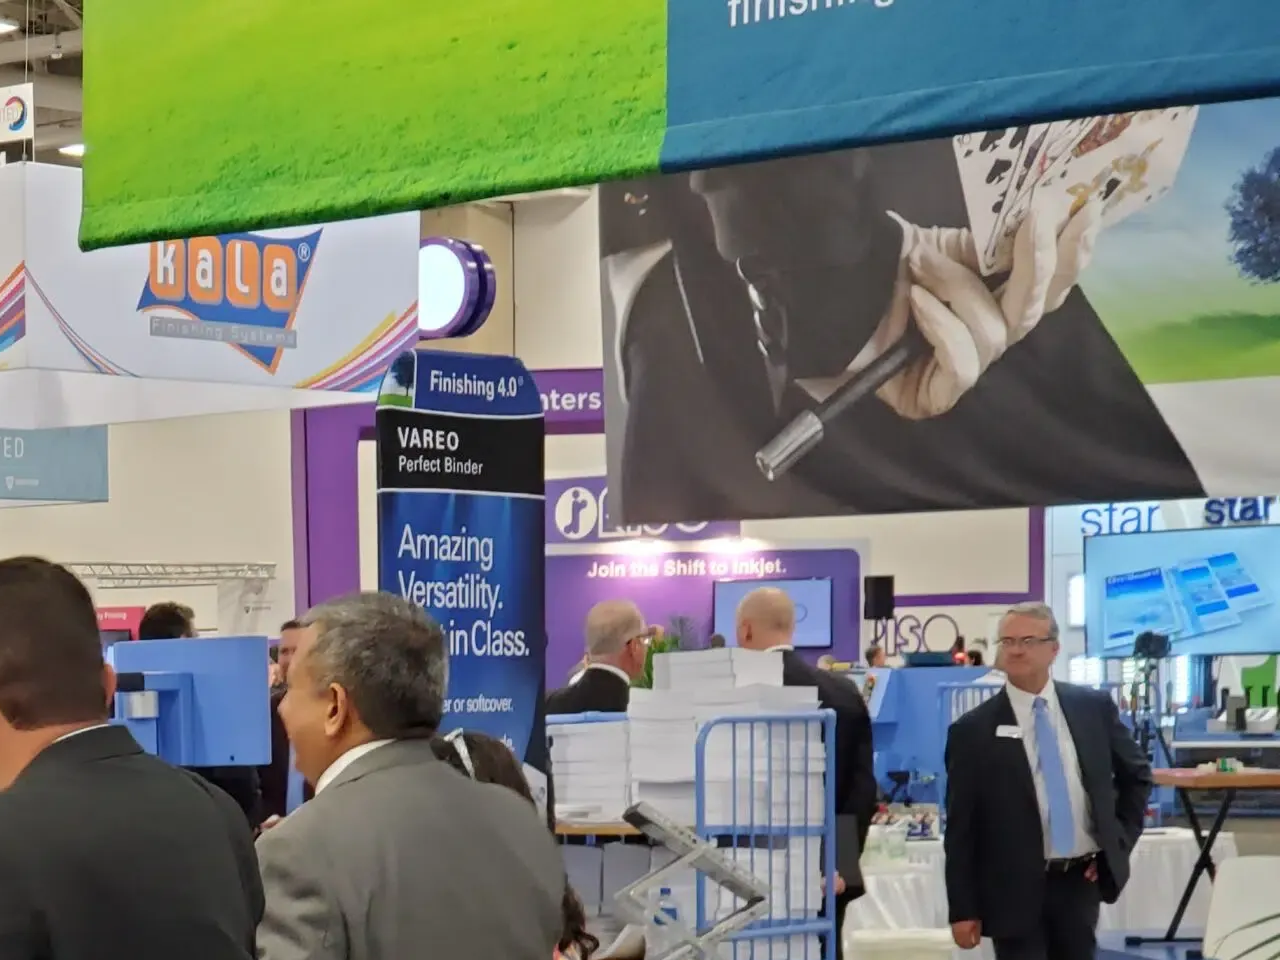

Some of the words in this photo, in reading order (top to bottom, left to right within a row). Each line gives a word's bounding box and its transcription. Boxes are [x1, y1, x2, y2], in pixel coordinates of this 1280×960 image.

[430, 370, 495, 401] Finishing
[397, 426, 459, 451] VAREO
[398, 455, 441, 473] Perfect
[444, 457, 483, 475] Binder
[1081, 502, 1160, 537] star
[398, 523, 493, 571] Amazing
[587, 562, 626, 578] Join
[630, 559, 658, 576] the
[663, 559, 705, 576] Shift
[710, 560, 728, 574] to
[732, 556, 787, 577] Inkjet.
[398, 570, 503, 617] Versatility.
[449, 619, 468, 656] in
[471, 619, 530, 657] Class.
[454, 699, 465, 713] or
[467, 692, 514, 713] softcover.
